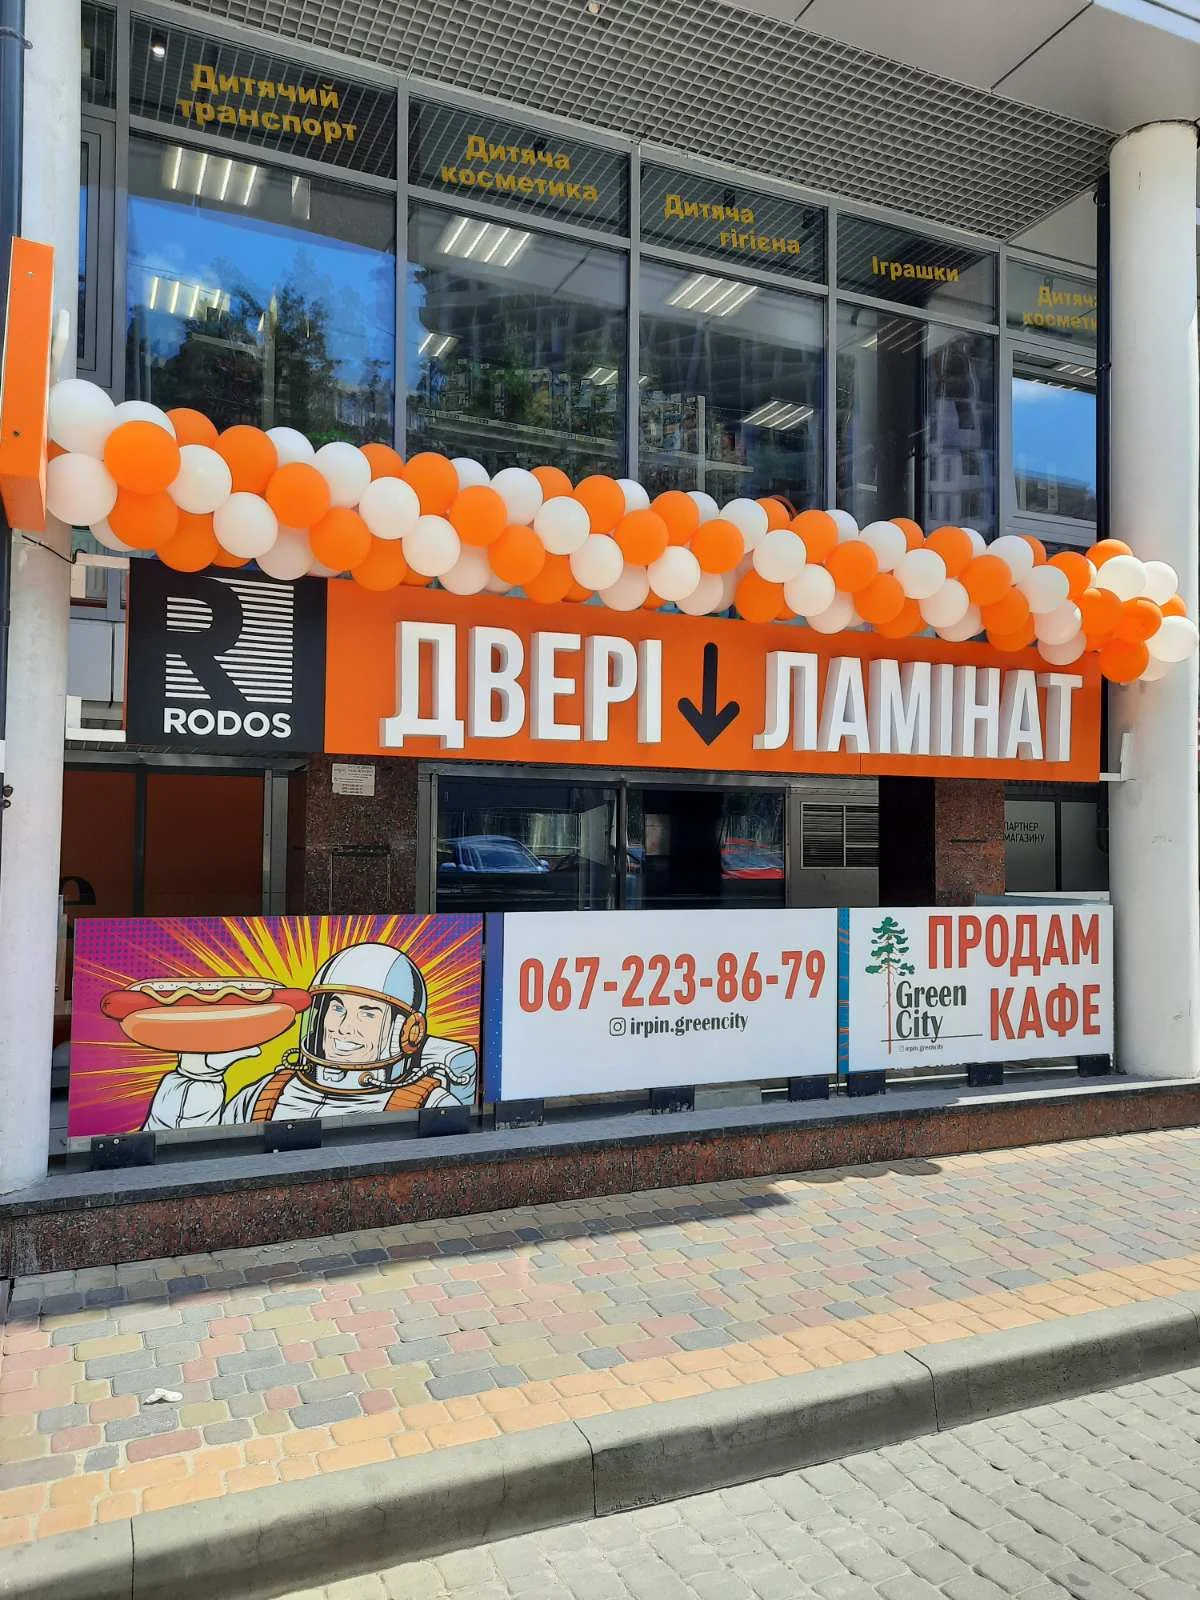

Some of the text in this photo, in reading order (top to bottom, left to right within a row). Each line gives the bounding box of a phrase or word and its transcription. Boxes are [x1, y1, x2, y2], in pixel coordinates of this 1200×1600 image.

[190, 63, 339, 109] Дитячий
[176, 98, 357, 144] транспорт
[465, 134, 571, 171] Дитяча
[440, 164, 598, 203] косметика
[664, 193, 755, 225] Дитяча
[719, 228, 800, 254] гігієна
[871, 255, 960, 282] Іграшки
[379, 620, 1083, 762] ДВЕРІ ЛАМІНАТ
[163, 707, 292, 738] RODOS
[928, 913, 1099, 977] ПРОДАМ
[518, 949, 826, 1013] 067-223-86-79
[896, 980, 967, 1009] Green
[630, 1011, 749, 1038] irpin.greencity
[895, 1009, 943, 1043] City
[990, 982, 1101, 1041] КАФЕ
